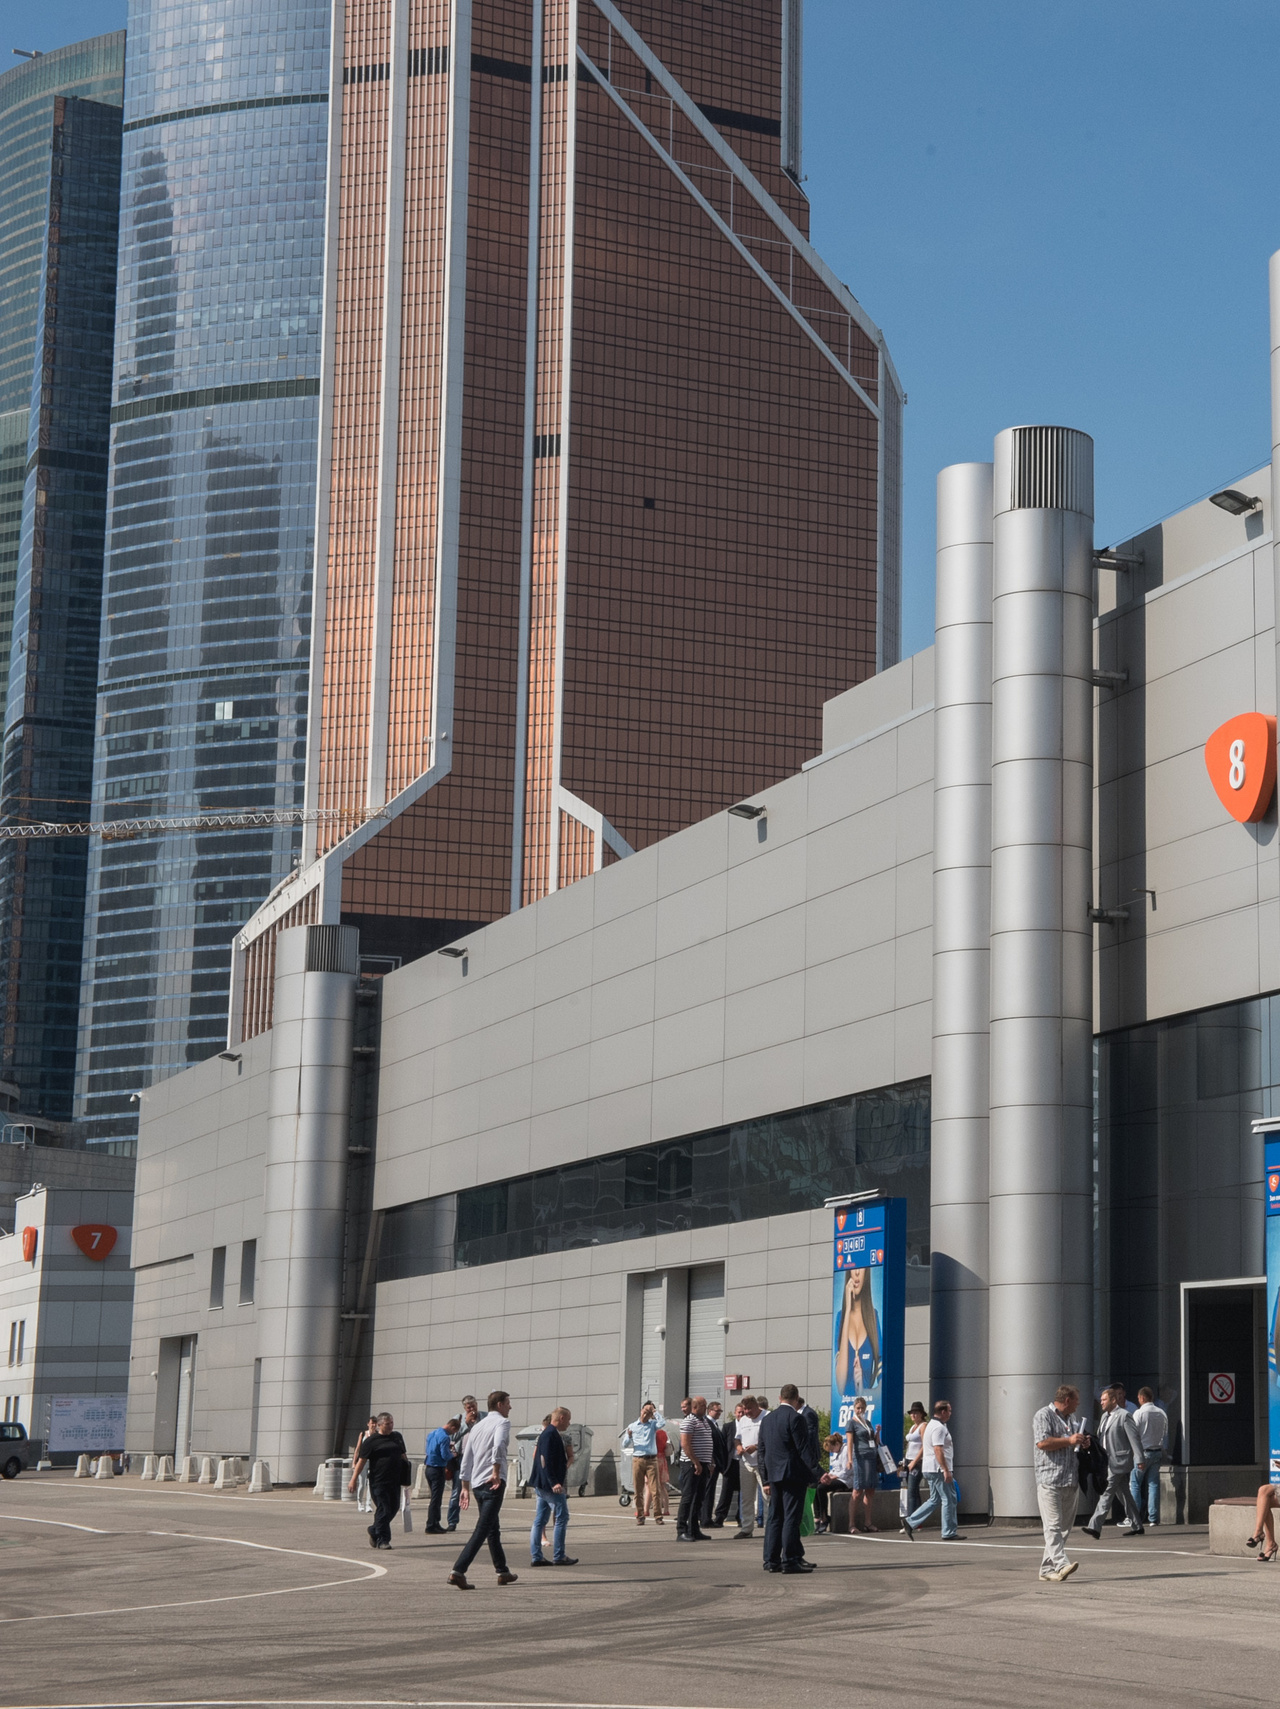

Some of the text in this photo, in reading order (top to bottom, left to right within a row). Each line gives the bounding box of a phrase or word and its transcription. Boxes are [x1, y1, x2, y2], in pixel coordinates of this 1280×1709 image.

[1229, 739, 1246, 790] 8
[859, 1211, 862, 1223] 8
[91, 1232, 102, 1249] 7
[838, 1404, 875, 1427] BOT
